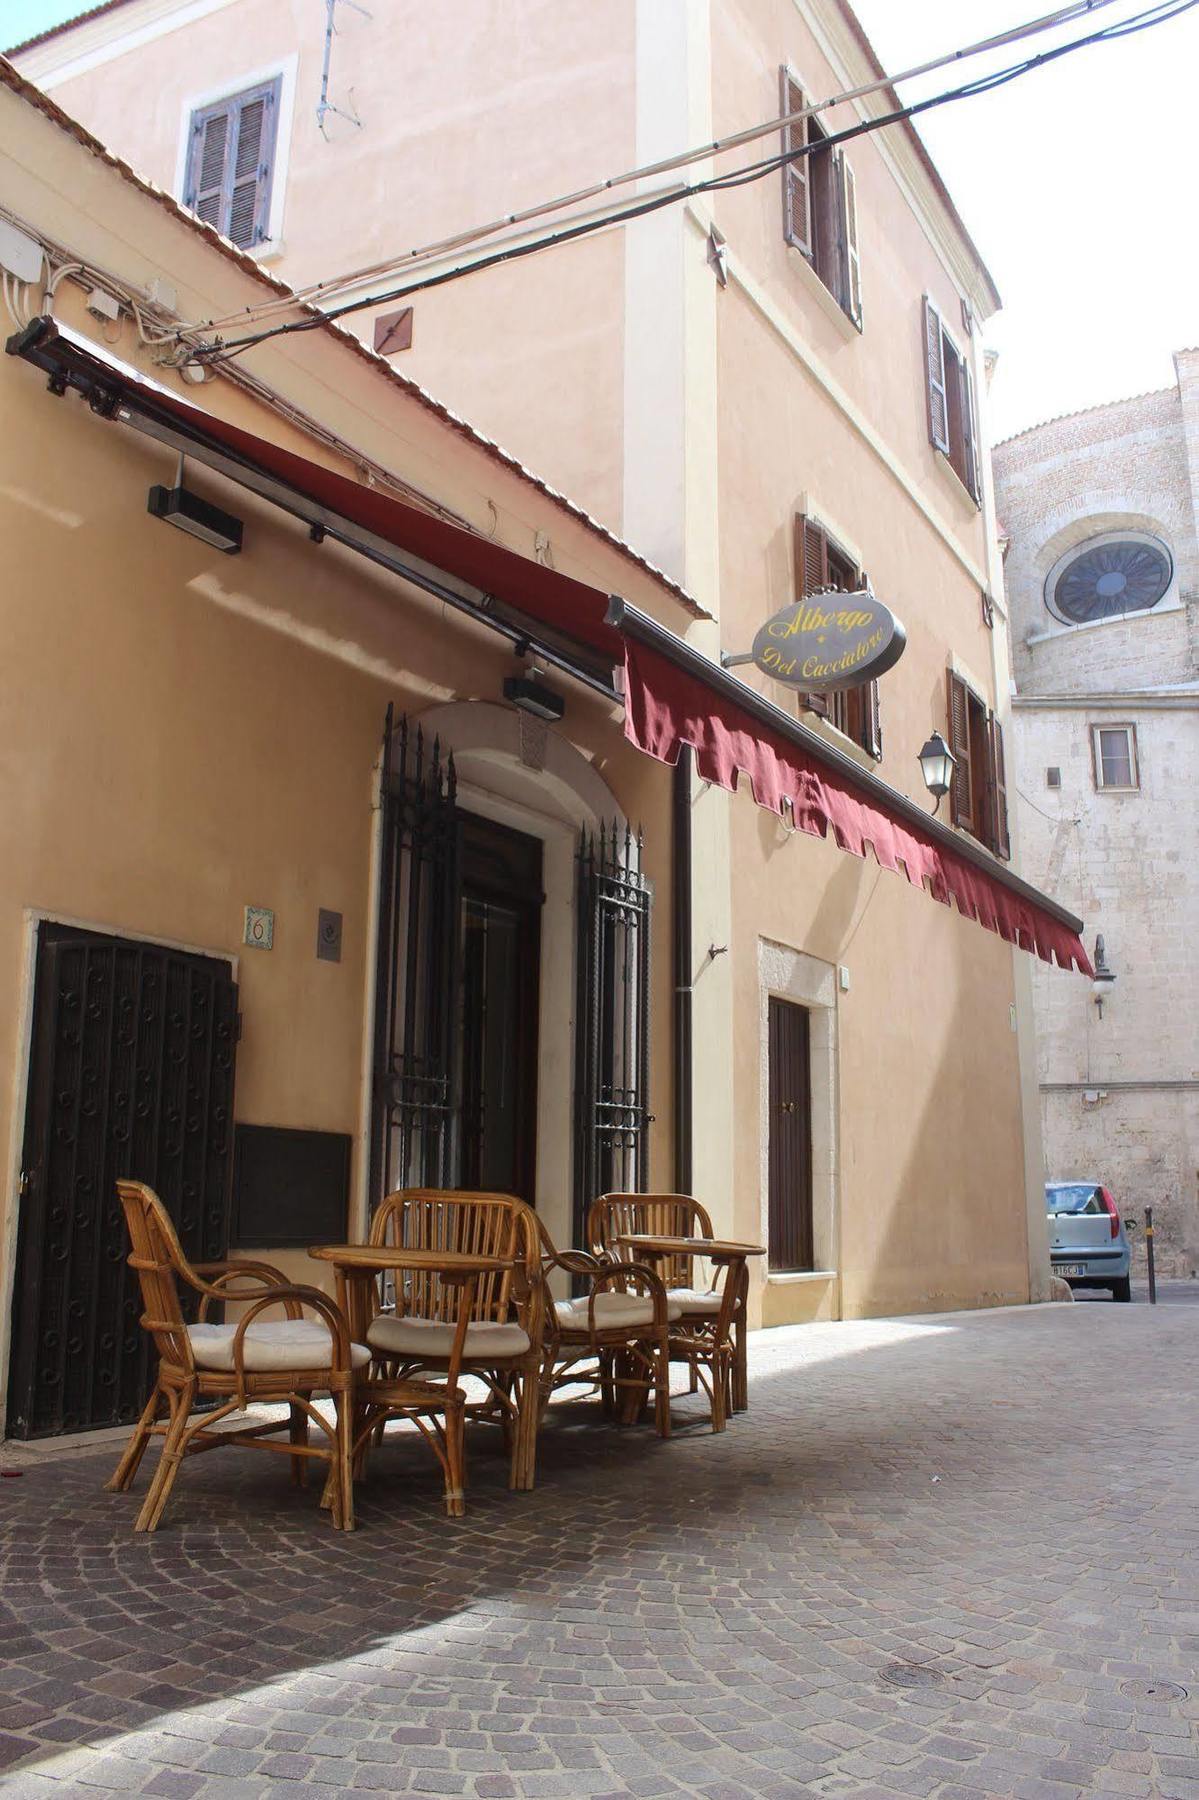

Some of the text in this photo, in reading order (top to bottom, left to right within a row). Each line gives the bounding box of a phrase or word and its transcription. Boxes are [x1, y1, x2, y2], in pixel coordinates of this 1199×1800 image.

[767, 604, 873, 638] Albergo
[761, 627, 885, 678] Del Cacciatore
[253, 917, 264, 940] 6
